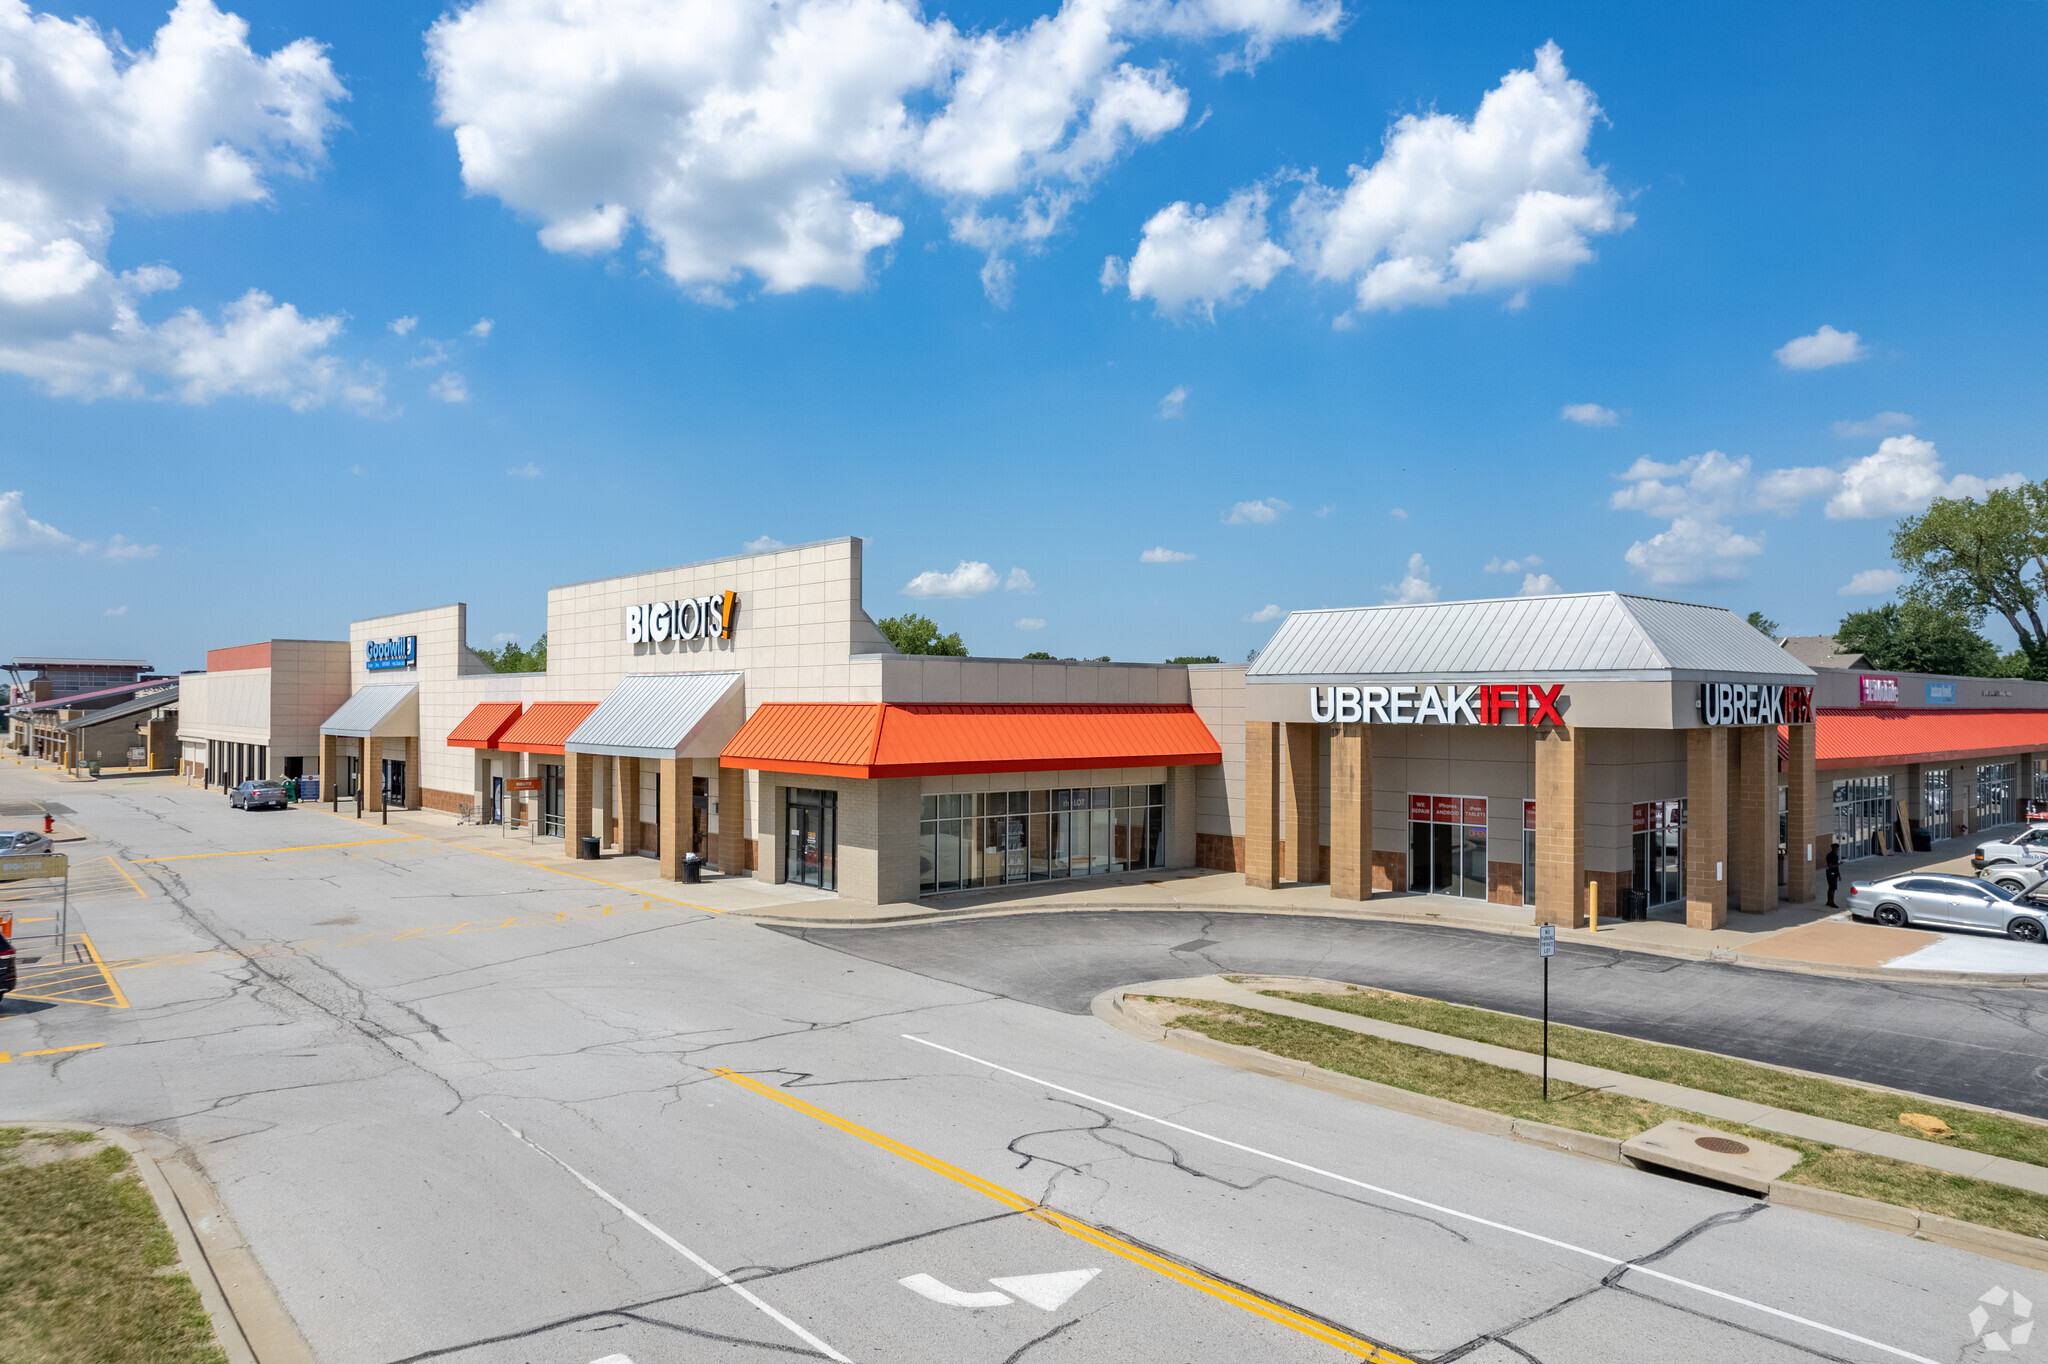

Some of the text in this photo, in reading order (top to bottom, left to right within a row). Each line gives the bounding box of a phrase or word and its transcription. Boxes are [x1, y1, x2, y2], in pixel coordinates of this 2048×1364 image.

[366, 636, 406, 659] Goodwill
[1310, 684, 1565, 725] UBREAKIFIX
[1704, 683, 1815, 726] UBREAKIFIX
[1468, 829, 1487, 838] OPEN
